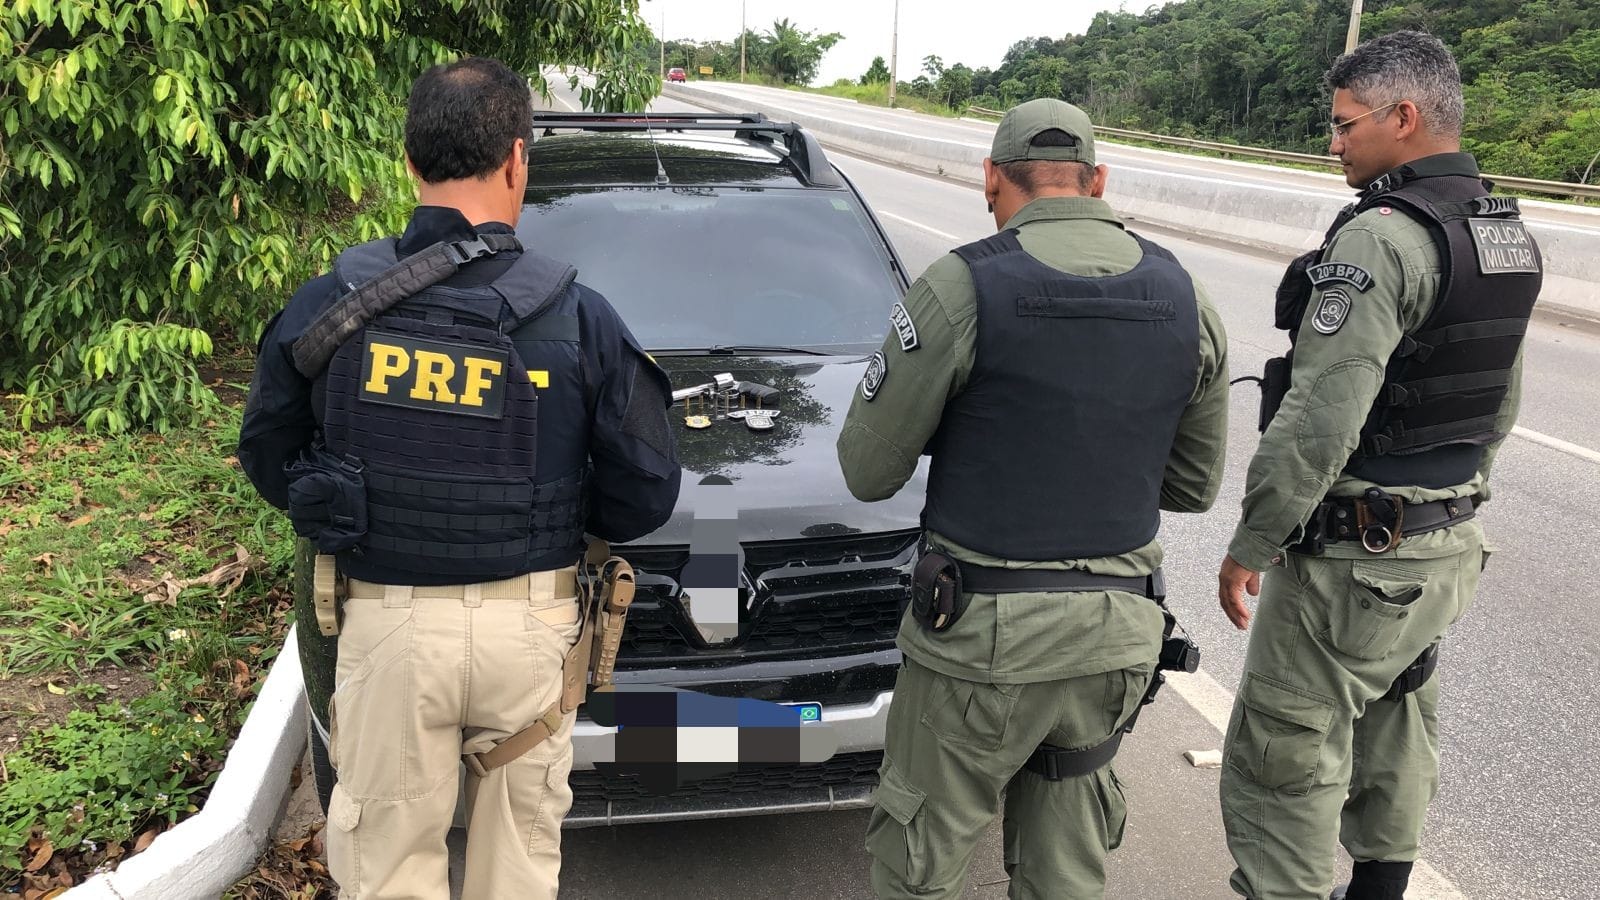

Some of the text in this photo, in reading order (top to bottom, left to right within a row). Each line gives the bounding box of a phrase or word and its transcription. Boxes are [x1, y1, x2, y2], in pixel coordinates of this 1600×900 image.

[1477, 222, 1528, 244] POLÍCIA
[1484, 248, 1535, 268] MILITAR
[1336, 265, 1366, 284] BPM
[365, 342, 502, 407] PRF
